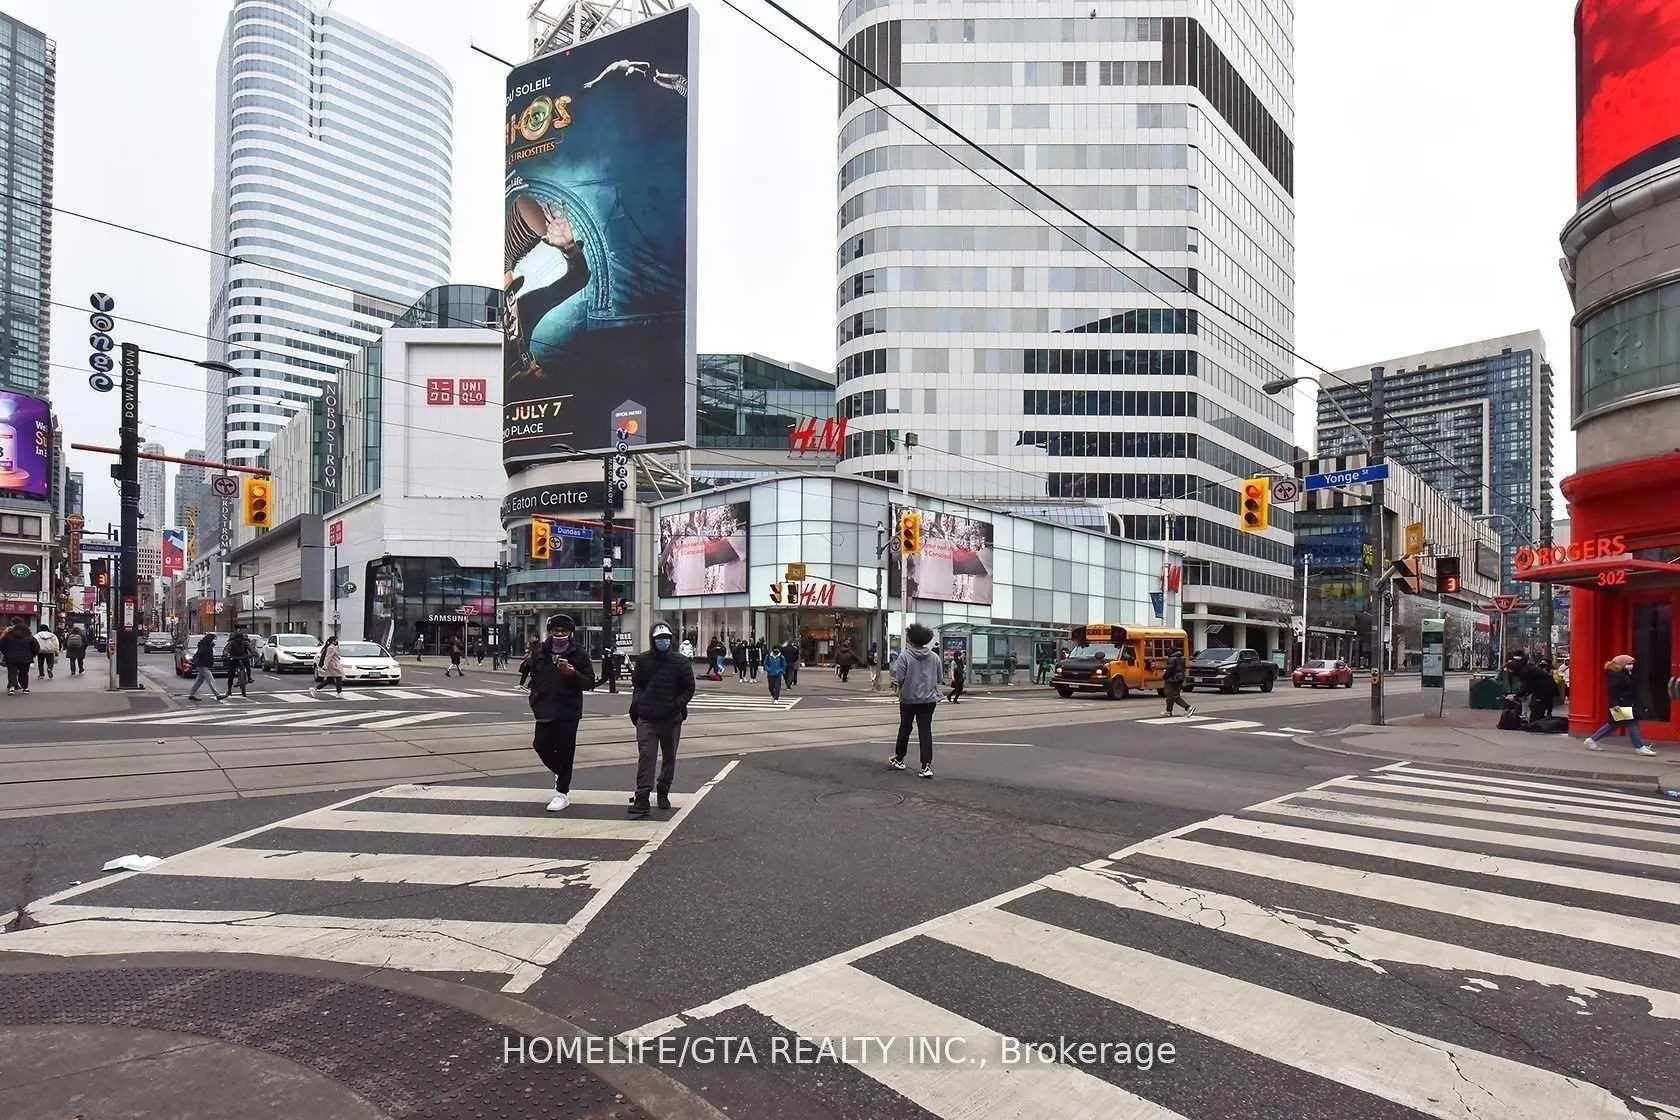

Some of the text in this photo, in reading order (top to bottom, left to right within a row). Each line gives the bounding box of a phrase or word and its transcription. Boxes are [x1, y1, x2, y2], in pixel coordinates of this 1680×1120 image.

[515, 78, 551, 97] SOLEIL
[125, 348, 136, 418] DOWNTOWN
[462, 382, 481, 391] UNI
[462, 393, 483, 402] QLO
[511, 402, 562, 421] JULY 7
[324, 384, 337, 488] NORDSTROM
[511, 423, 544, 436] PLACE
[789, 416, 848, 456] H&M
[1324, 471, 1359, 486] Yonge
[513, 495, 537, 511] Eaton
[541, 490, 588, 506] Centre
[557, 526, 580, 536] Dundas
[1538, 535, 1626, 565] ROGERS
[1597, 569, 1626, 586] 302
[615, 633, 632, 641] FREE
